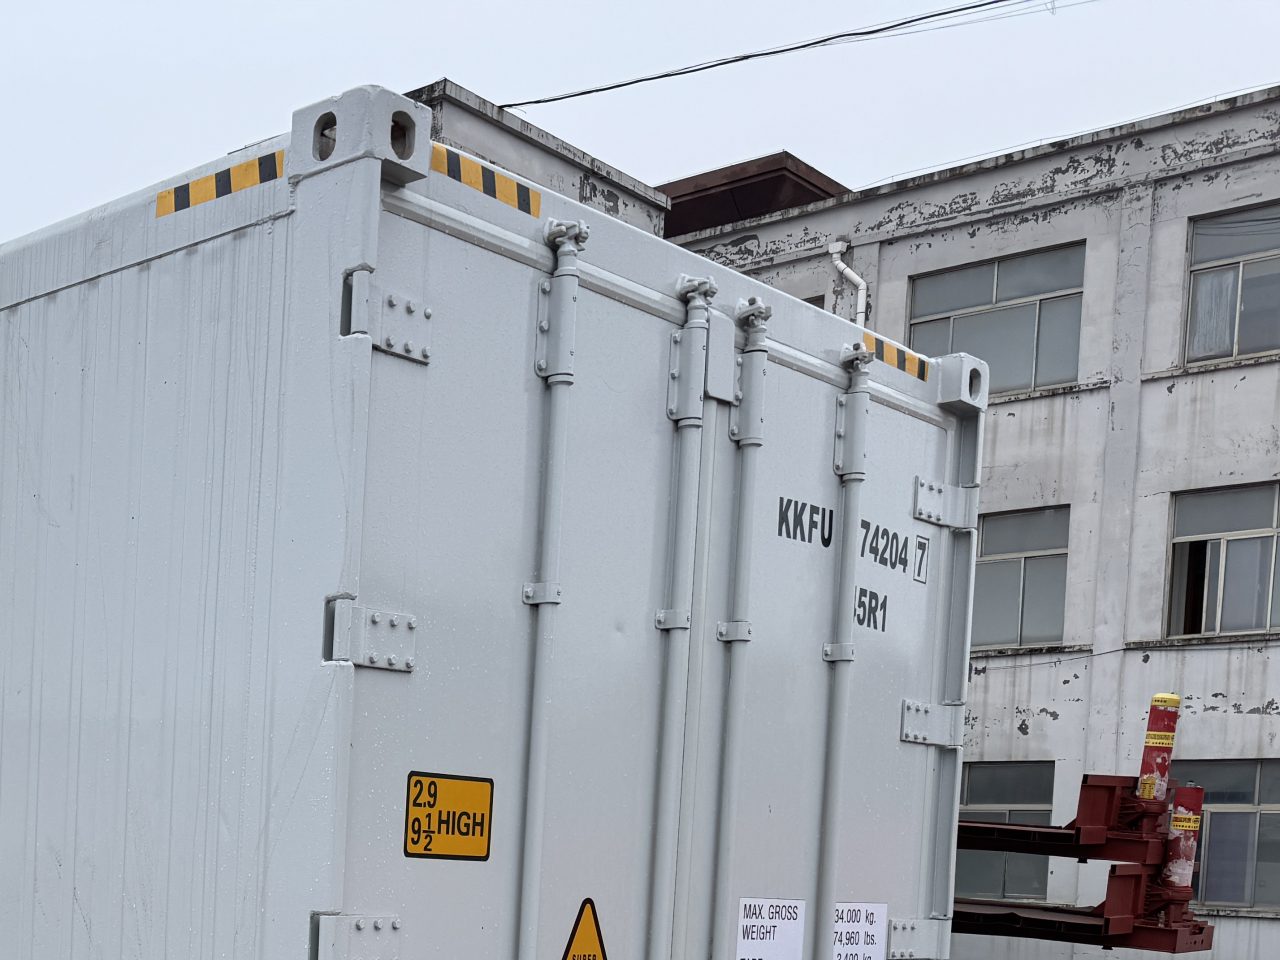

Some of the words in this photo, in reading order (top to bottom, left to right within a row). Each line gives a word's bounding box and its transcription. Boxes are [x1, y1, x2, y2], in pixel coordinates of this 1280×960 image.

[777, 496, 833, 548] KKFU
[860, 519, 909, 573] 74204
[853, 585, 888, 632] 5R1
[412, 779, 438, 808] 2.9
[437, 810, 485, 837] HIGH
[743, 904, 765, 919] MAX.
[768, 904, 798, 920] GROSS
[834, 909, 861, 923] 34.000
[865, 909, 876, 925] kg.
[742, 924, 777, 940] WEIGHT
[864, 931, 877, 945] lbs.
